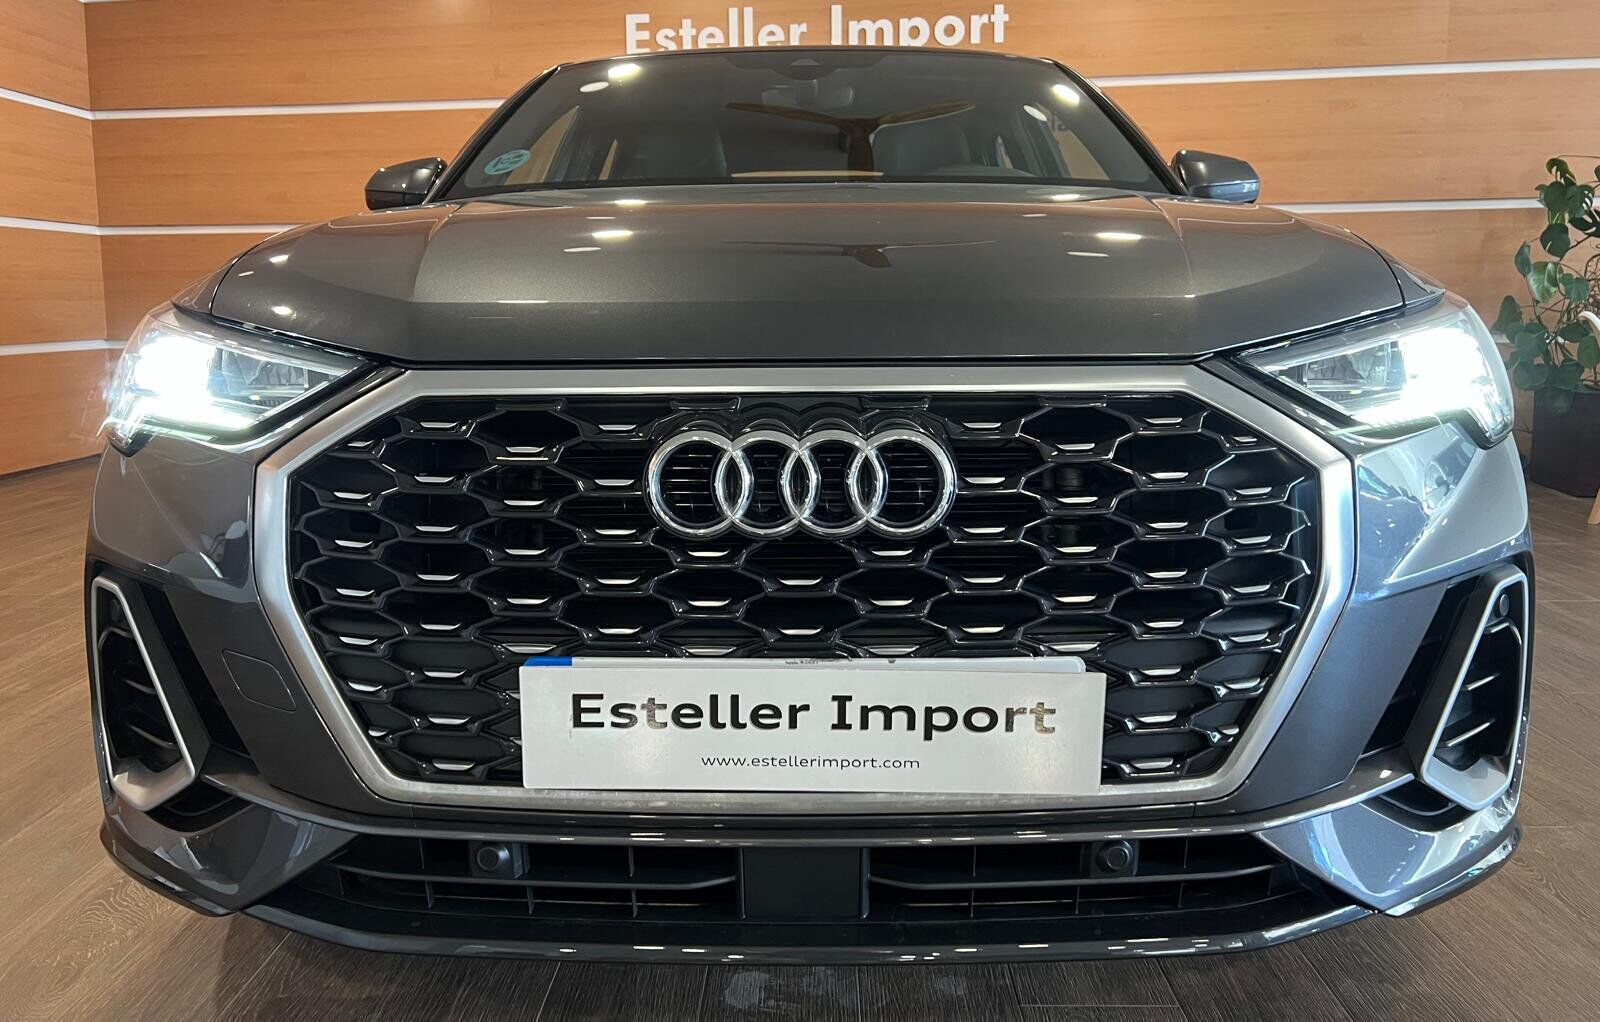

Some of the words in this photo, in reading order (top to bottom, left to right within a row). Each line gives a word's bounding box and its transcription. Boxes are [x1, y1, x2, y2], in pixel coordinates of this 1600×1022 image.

[625, 7, 807, 54] Esteller
[831, 4, 1009, 46] Import
[572, 693, 810, 730] Esteller
[831, 695, 1056, 741] Import
[701, 755, 920, 771] www.estellerimport.com
